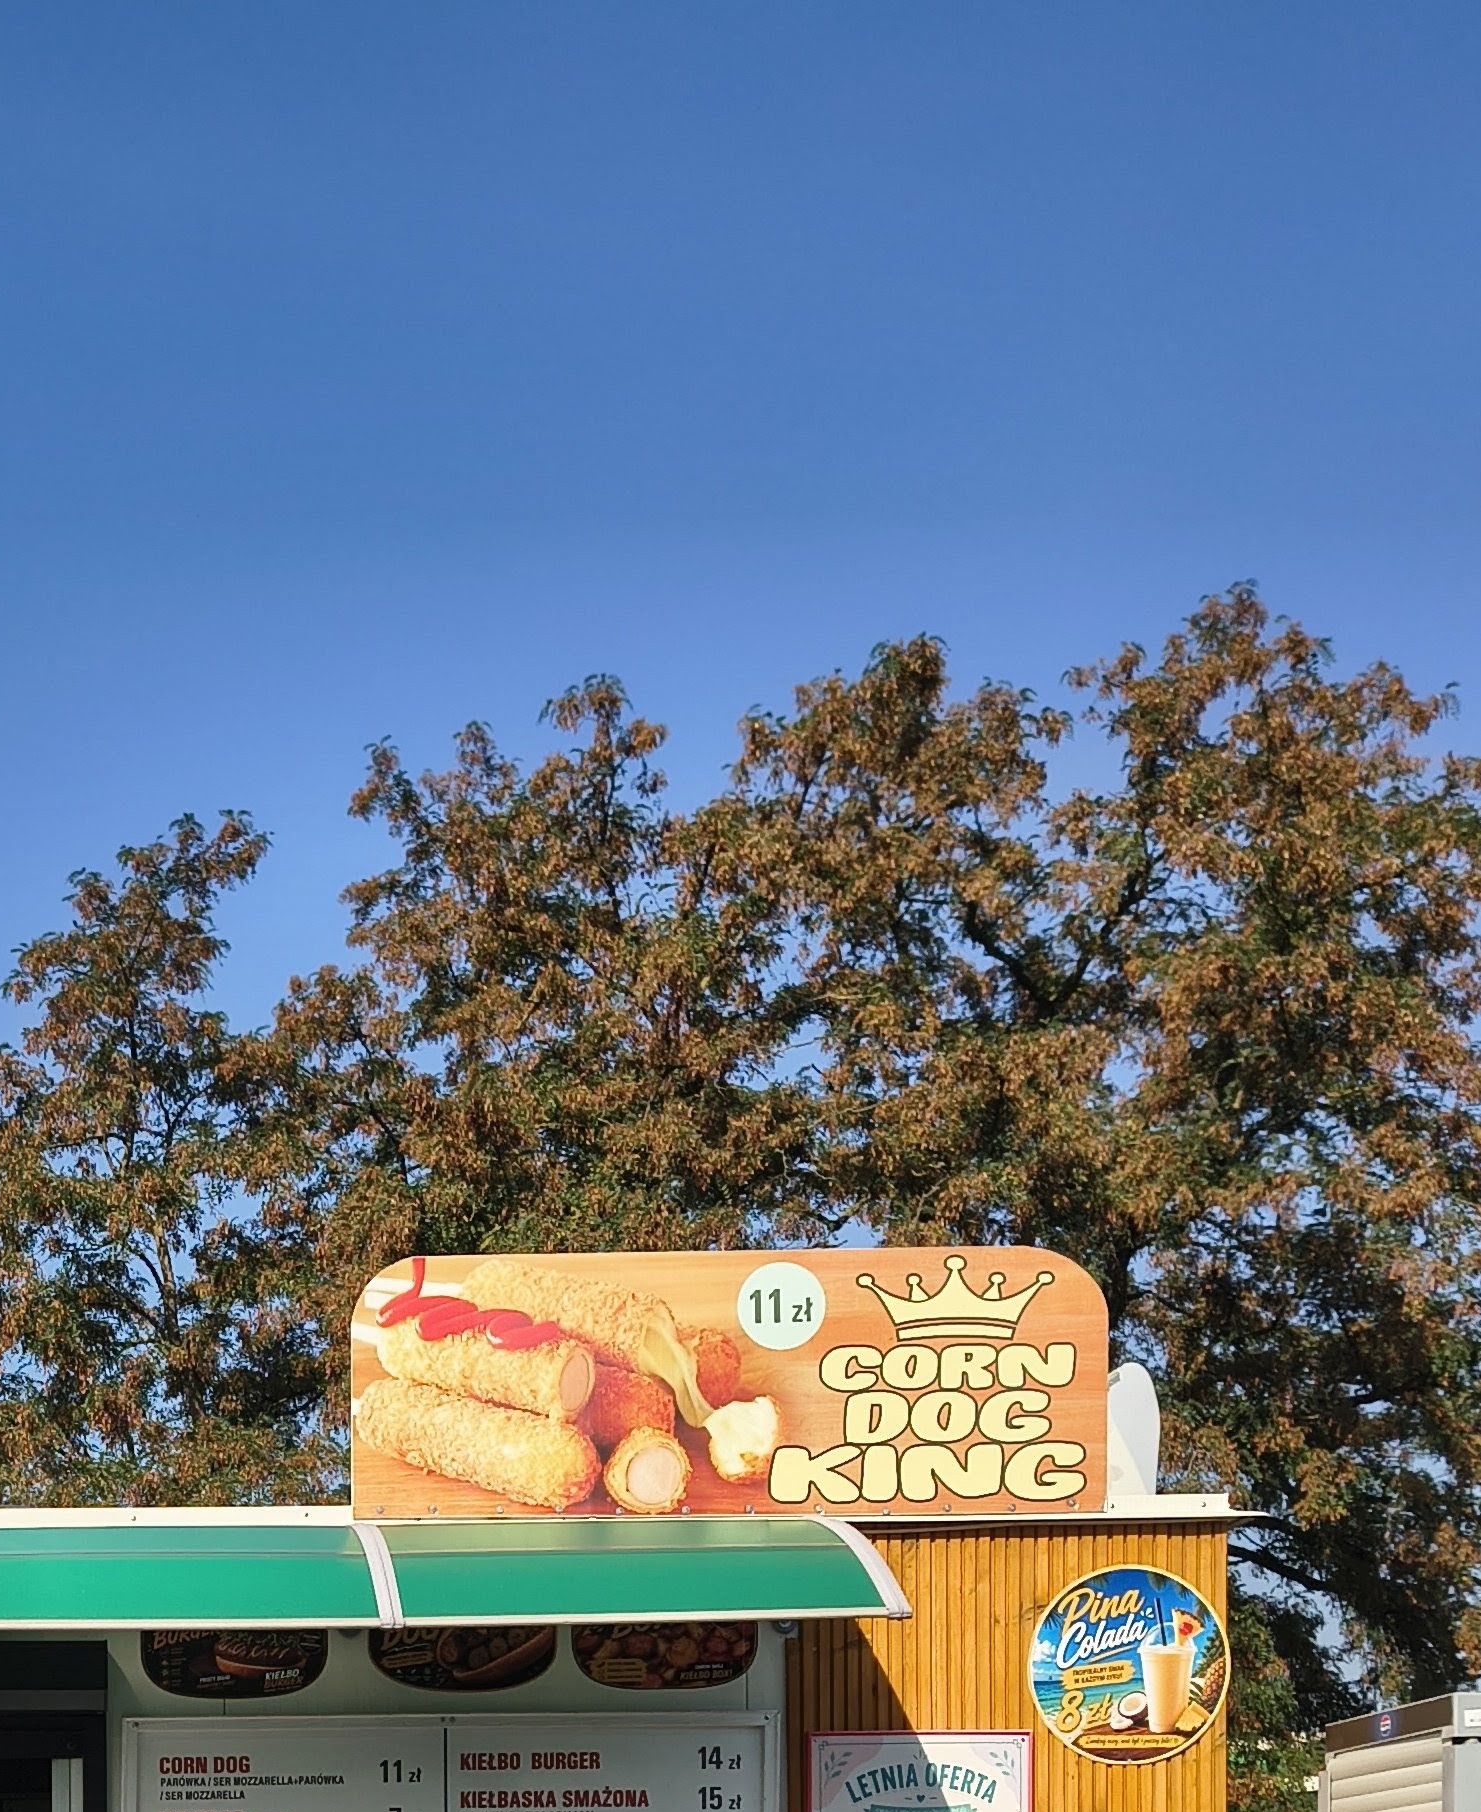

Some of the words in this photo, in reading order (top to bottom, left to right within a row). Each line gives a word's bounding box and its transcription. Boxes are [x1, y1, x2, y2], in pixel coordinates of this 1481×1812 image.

[748, 1288, 785, 1328] 11
[790, 1295, 816, 1325] zł
[820, 1343, 1076, 1392] CORN
[845, 1390, 1051, 1444] DOG
[768, 1441, 1086, 1505] KING
[1058, 1587, 1145, 1639] Pina
[1056, 1614, 1149, 1669] Colada
[1056, 1689, 1084, 1732] 8
[1087, 1693, 1114, 1724] zł
[159, 1757, 207, 1774] CORN
[214, 1756, 250, 1773] DOG
[379, 1760, 402, 1783] 11
[409, 1767, 421, 1783] zł
[460, 1752, 520, 1770] KIEŁBO
[531, 1751, 601, 1770] BURGER
[697, 1746, 723, 1770] 14
[728, 1754, 742, 1770] zł
[186, 1790, 245, 1800] MOZZARELLA
[460, 1790, 556, 1808] KIEŁBASKA
[562, 1786, 649, 1808] SMAŻONA
[698, 1786, 722, 1810] 15
[728, 1794, 742, 1810] zł
[845, 1763, 919, 1803] LETNIA
[925, 1762, 997, 1803] OFERTA
